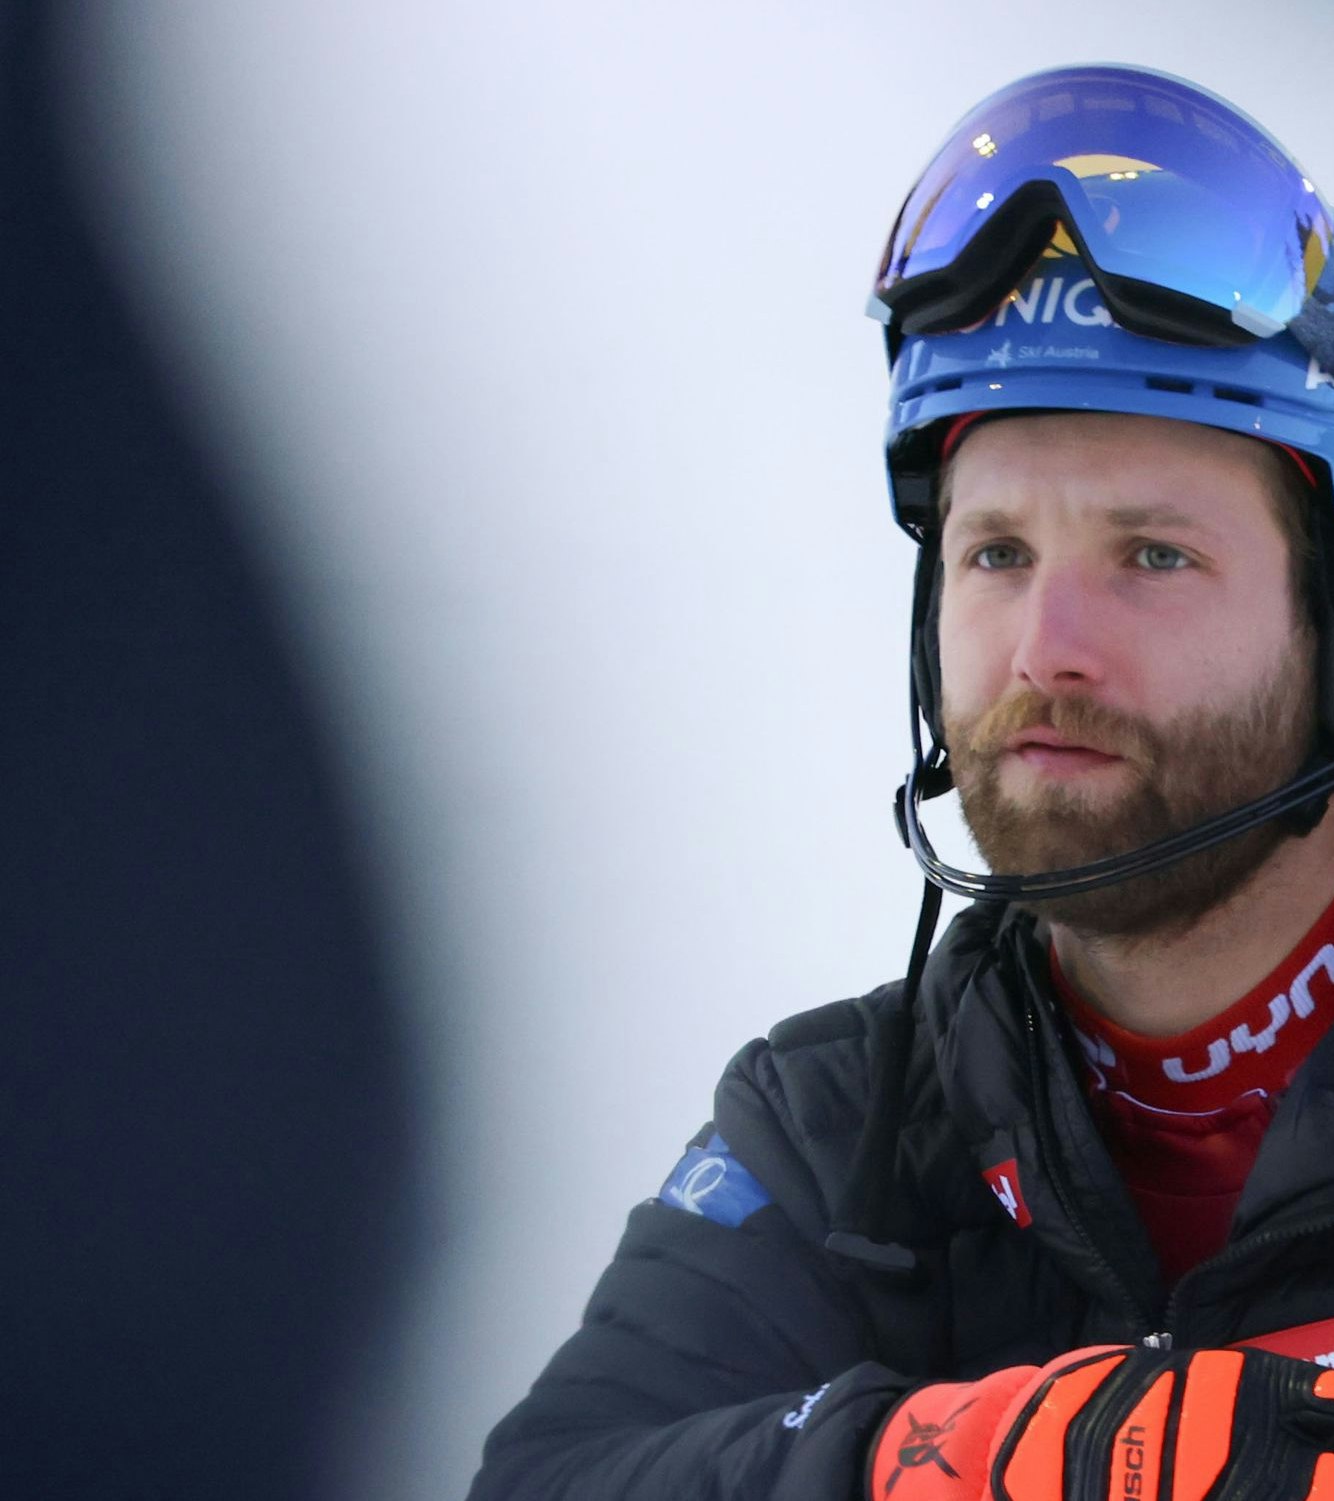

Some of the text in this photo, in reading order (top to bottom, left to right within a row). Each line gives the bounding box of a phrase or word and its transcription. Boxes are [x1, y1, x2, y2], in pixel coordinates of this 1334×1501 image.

[960, 277, 1121, 334] NIQ
[1018, 346, 1100, 360] Ski Austria
[1120, 1425, 1147, 1501] sch
